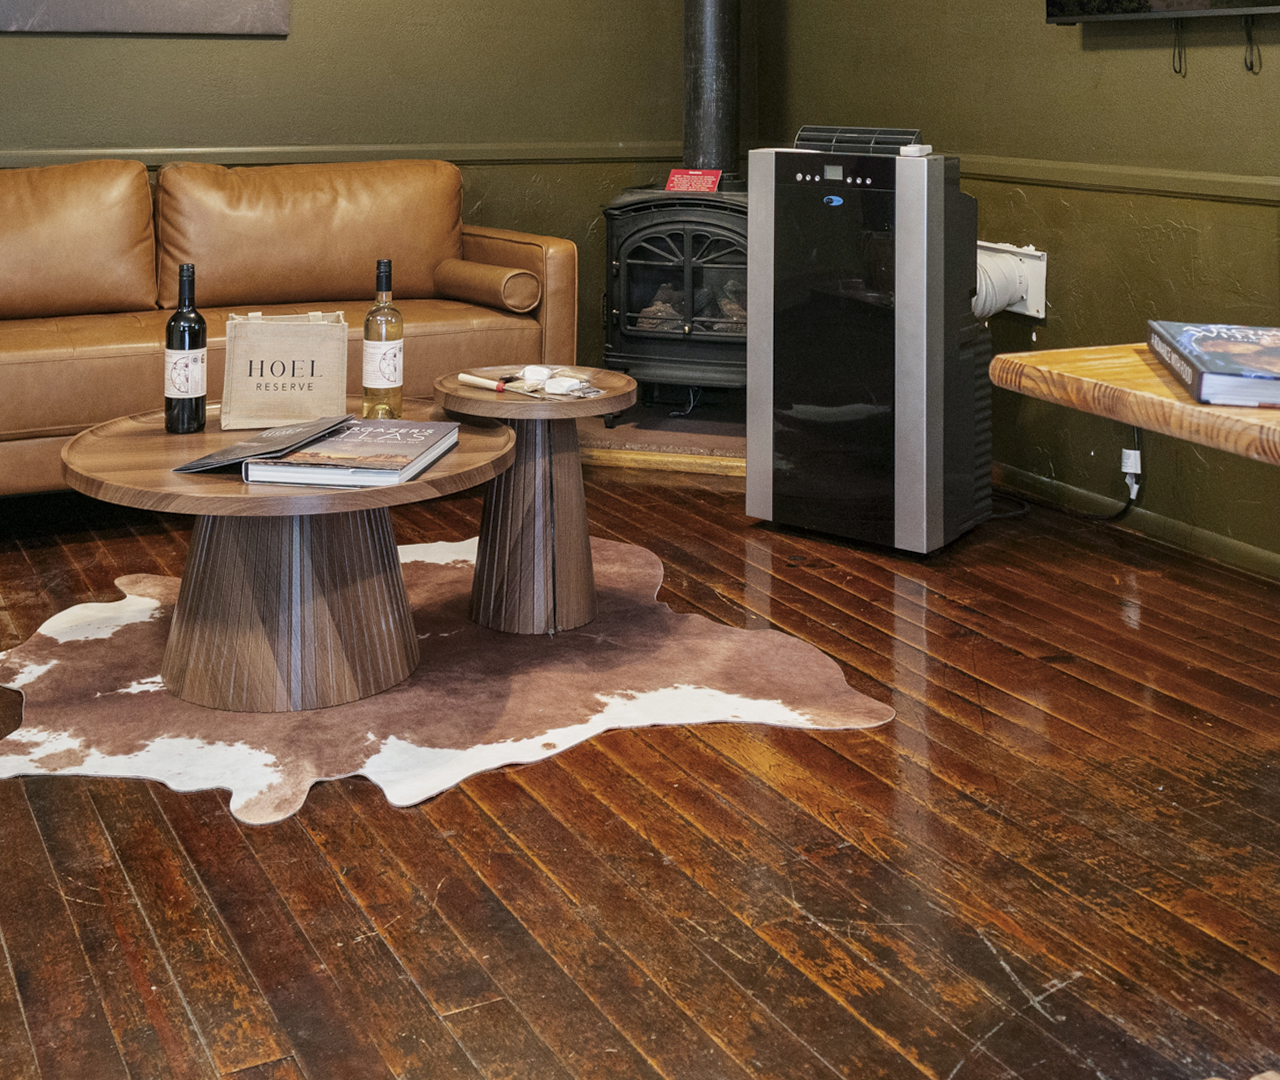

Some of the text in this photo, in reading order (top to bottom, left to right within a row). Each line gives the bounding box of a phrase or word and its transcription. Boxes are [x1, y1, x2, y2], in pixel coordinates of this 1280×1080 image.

[247, 359, 324, 378] HOEL
[255, 382, 314, 392] RESERVE
[349, 426, 435, 435] RGAZER'S
[340, 431, 430, 441] TLAS
